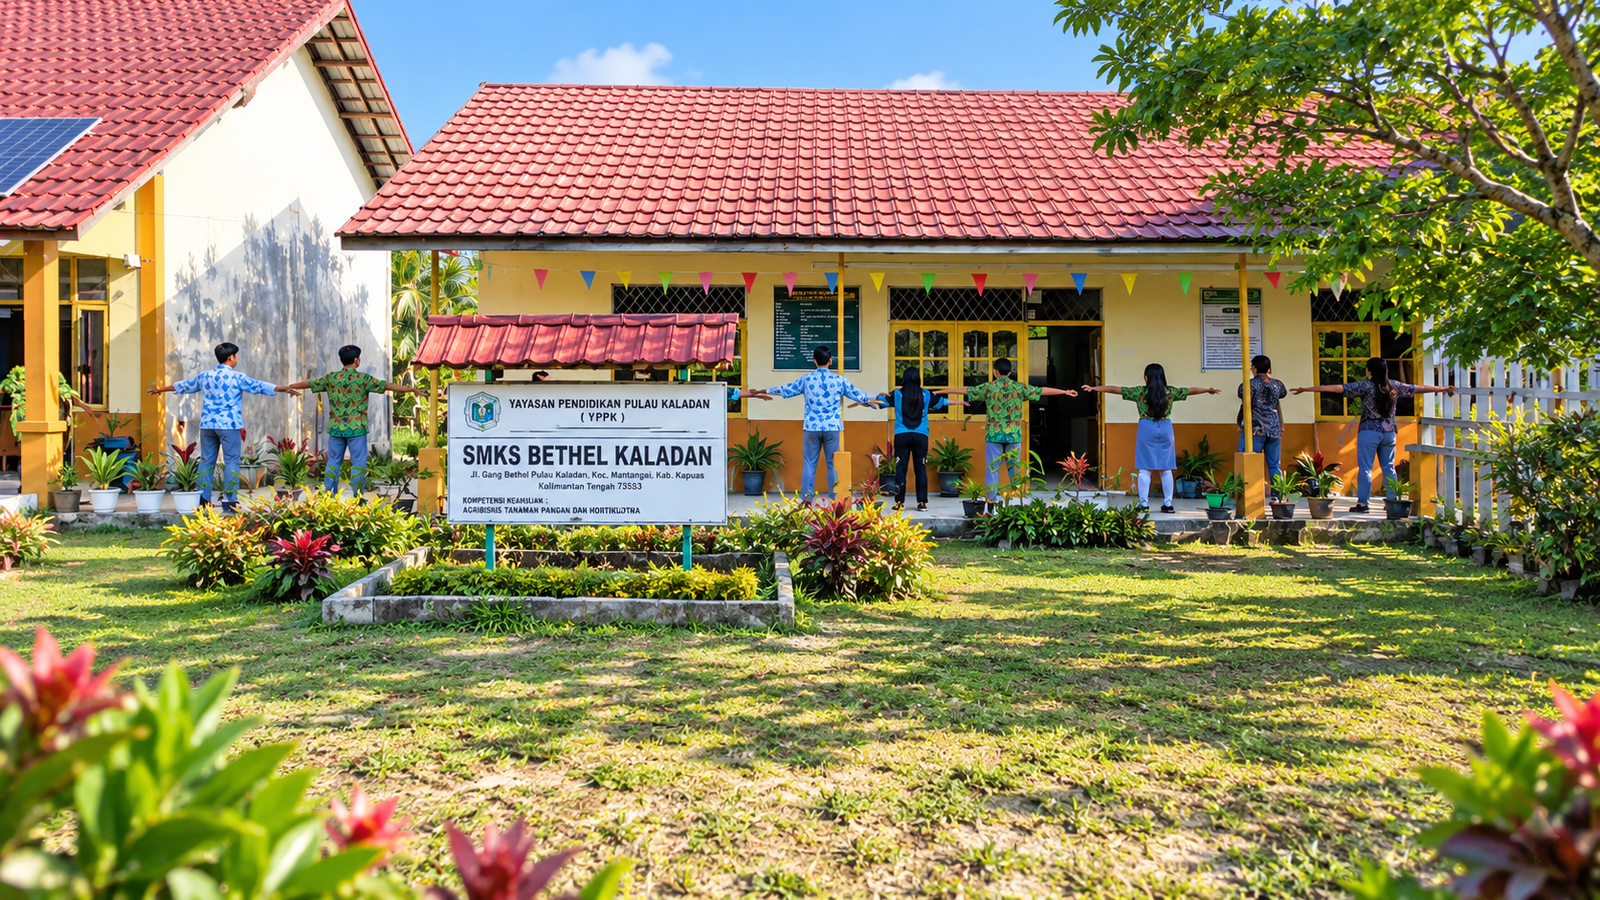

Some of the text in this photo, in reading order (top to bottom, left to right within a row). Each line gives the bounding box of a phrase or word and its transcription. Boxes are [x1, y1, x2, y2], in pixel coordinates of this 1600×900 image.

[509, 399, 710, 409] YAYASAN PENDIDIKAN PULAU KALADAN
[463, 445, 712, 466] SMKS BETHEL KALADAN
[482, 470, 503, 480] Gang
[504, 470, 529, 479] Bethel
[531, 470, 554, 479] Pulau
[556, 471, 590, 480] Kaladan,
[656, 471, 674, 480] Kab.
[676, 471, 705, 481] Kapuas
[587, 482, 616, 492] Tengah
